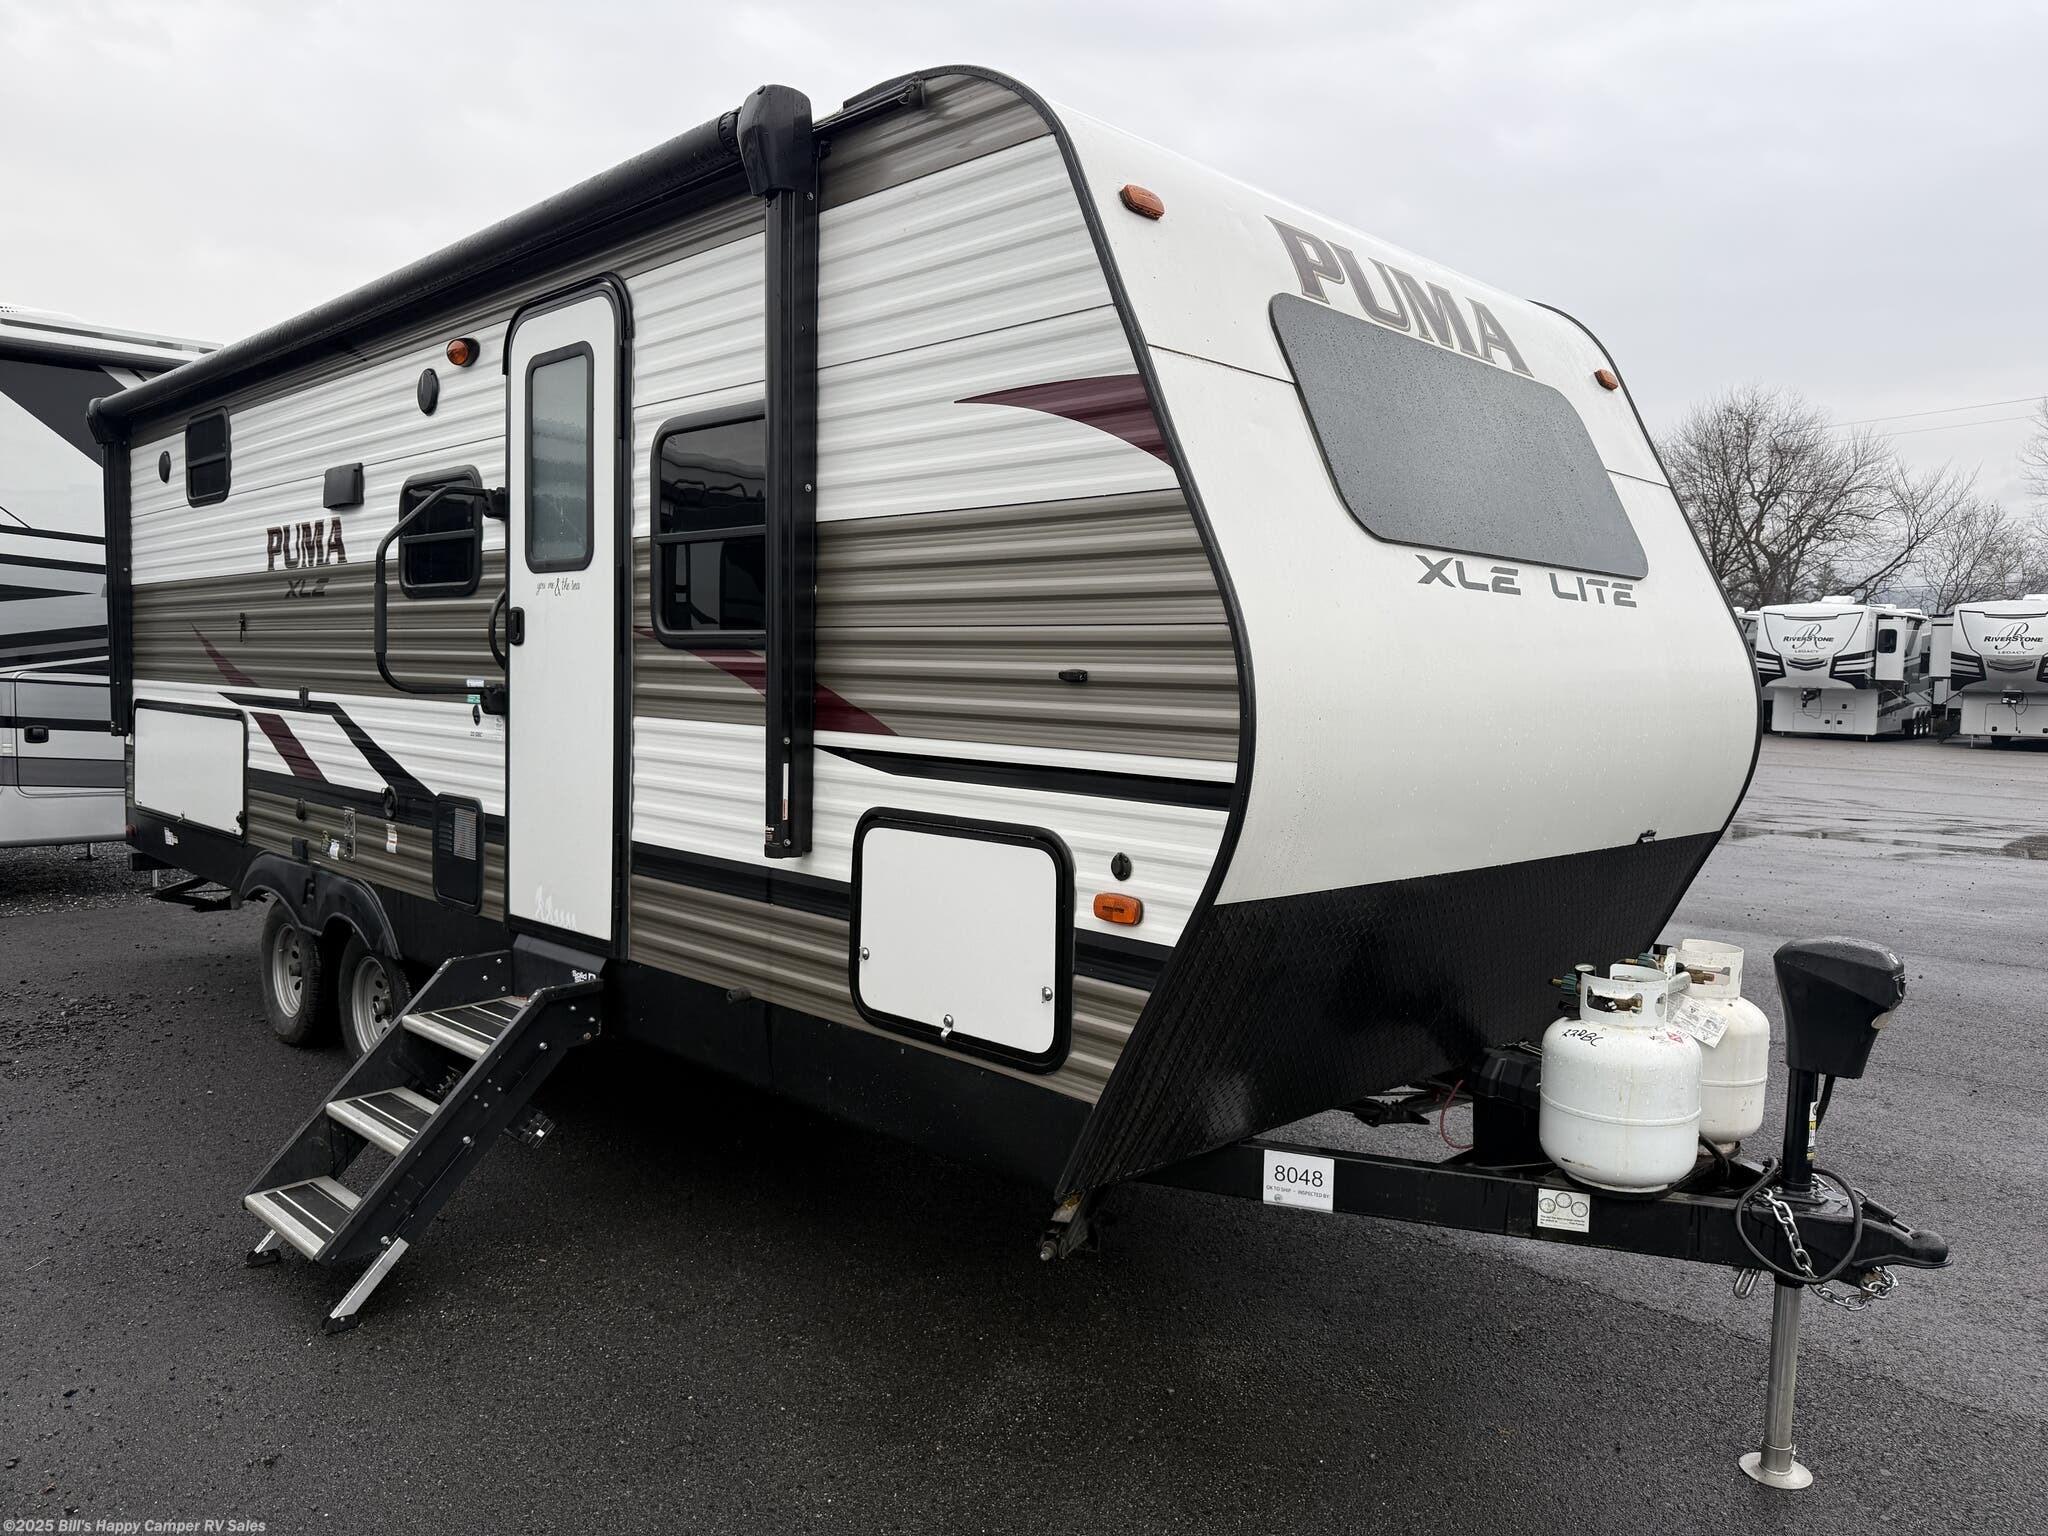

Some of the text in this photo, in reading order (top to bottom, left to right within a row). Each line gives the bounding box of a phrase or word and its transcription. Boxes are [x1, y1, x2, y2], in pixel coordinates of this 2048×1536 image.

[1264, 215, 1535, 378] PUMA
[267, 516, 348, 571] PUMA
[554, 577, 561, 597] &
[1415, 554, 1637, 608] XLE LITE
[1274, 1164, 1323, 1188] 8048
